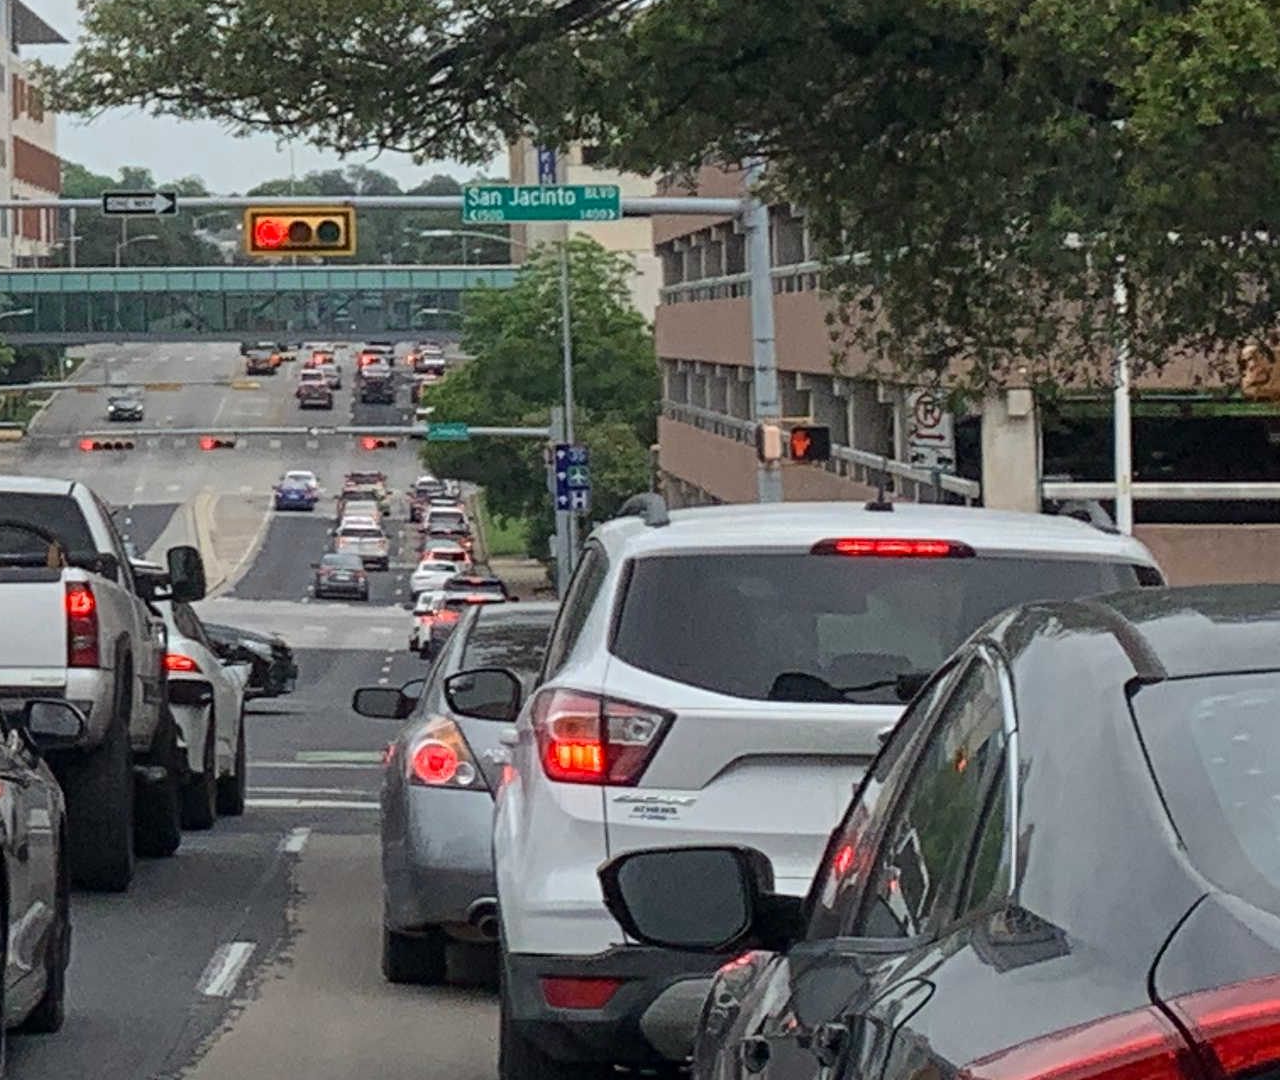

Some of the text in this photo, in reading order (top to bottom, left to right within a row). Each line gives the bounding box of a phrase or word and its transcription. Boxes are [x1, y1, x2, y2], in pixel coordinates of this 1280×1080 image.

[468, 186, 617, 207] San Jacinto BLVD
